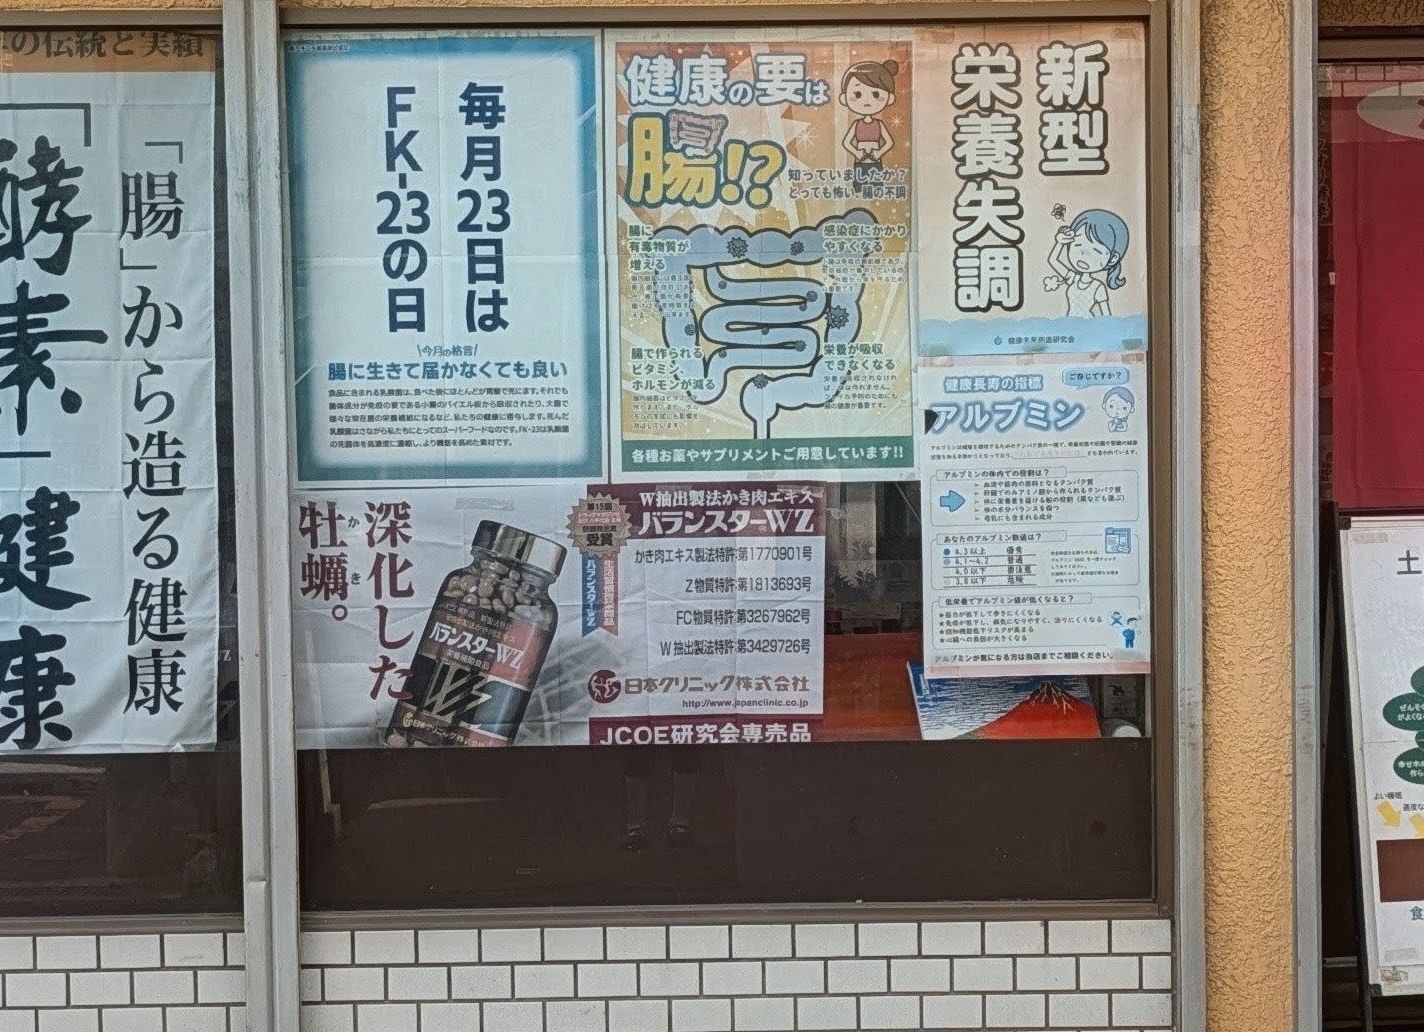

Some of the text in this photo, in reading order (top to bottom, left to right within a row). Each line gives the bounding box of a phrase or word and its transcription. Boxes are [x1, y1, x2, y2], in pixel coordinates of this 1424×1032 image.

[627, 53, 830, 107] 健康の要は
[1036, 39, 1111, 176] 新型
[375, 85, 431, 334] FK-23の日
[456, 82, 512, 334] 毎月23日は
[950, 41, 1026, 314] 栄養失調
[327, 361, 569, 381] 腸に生きて届かなくても良い
[824, 359, 896, 371] できなくなる
[120, 141, 186, 717] 「腸」から造る健康
[929, 398, 1085, 434] アルブミン
[364, 500, 415, 701] 深化した
[624, 674, 811, 695] 日本クリニック株式会社
[599, 722, 812, 745] JCOE研究会専売品
